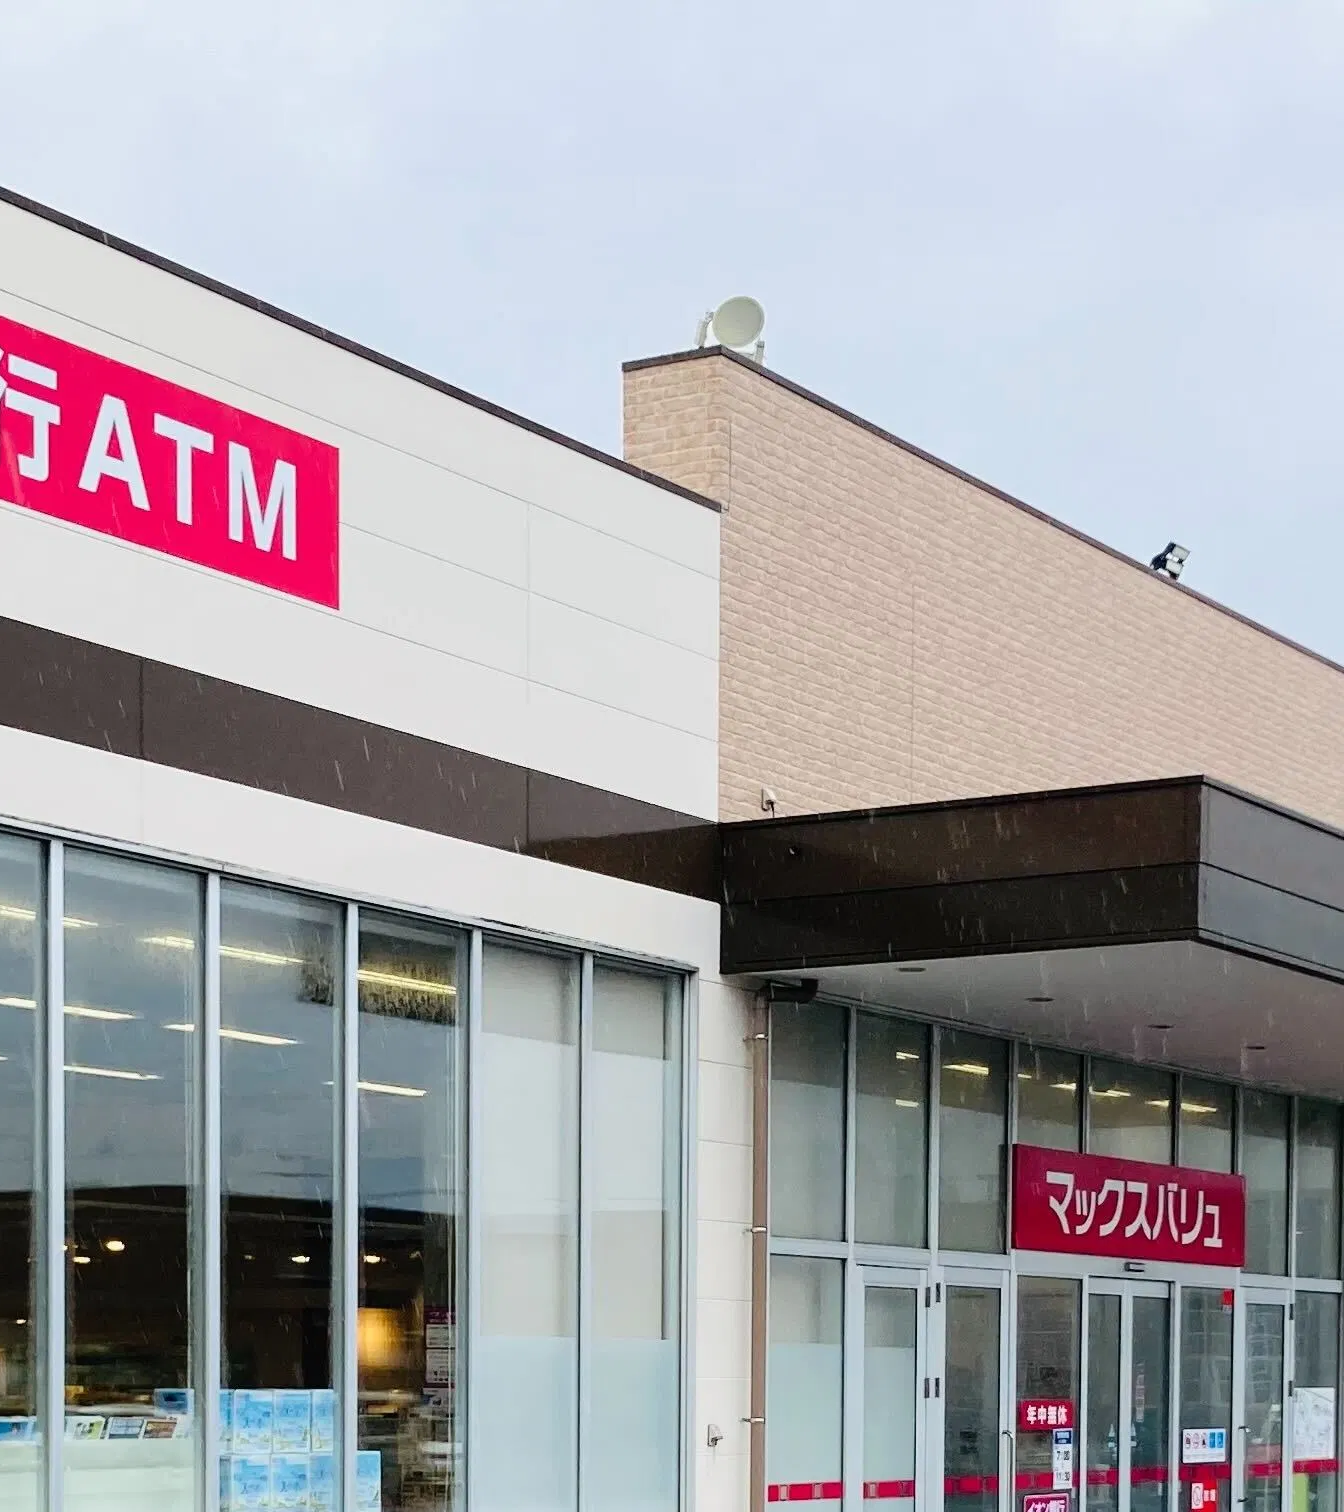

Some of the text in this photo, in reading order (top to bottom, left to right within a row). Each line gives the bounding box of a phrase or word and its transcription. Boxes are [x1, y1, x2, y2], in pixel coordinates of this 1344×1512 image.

[1045, 1170, 1224, 1249] マックスバリュ
[1026, 1404, 1068, 1425] 年中無休
